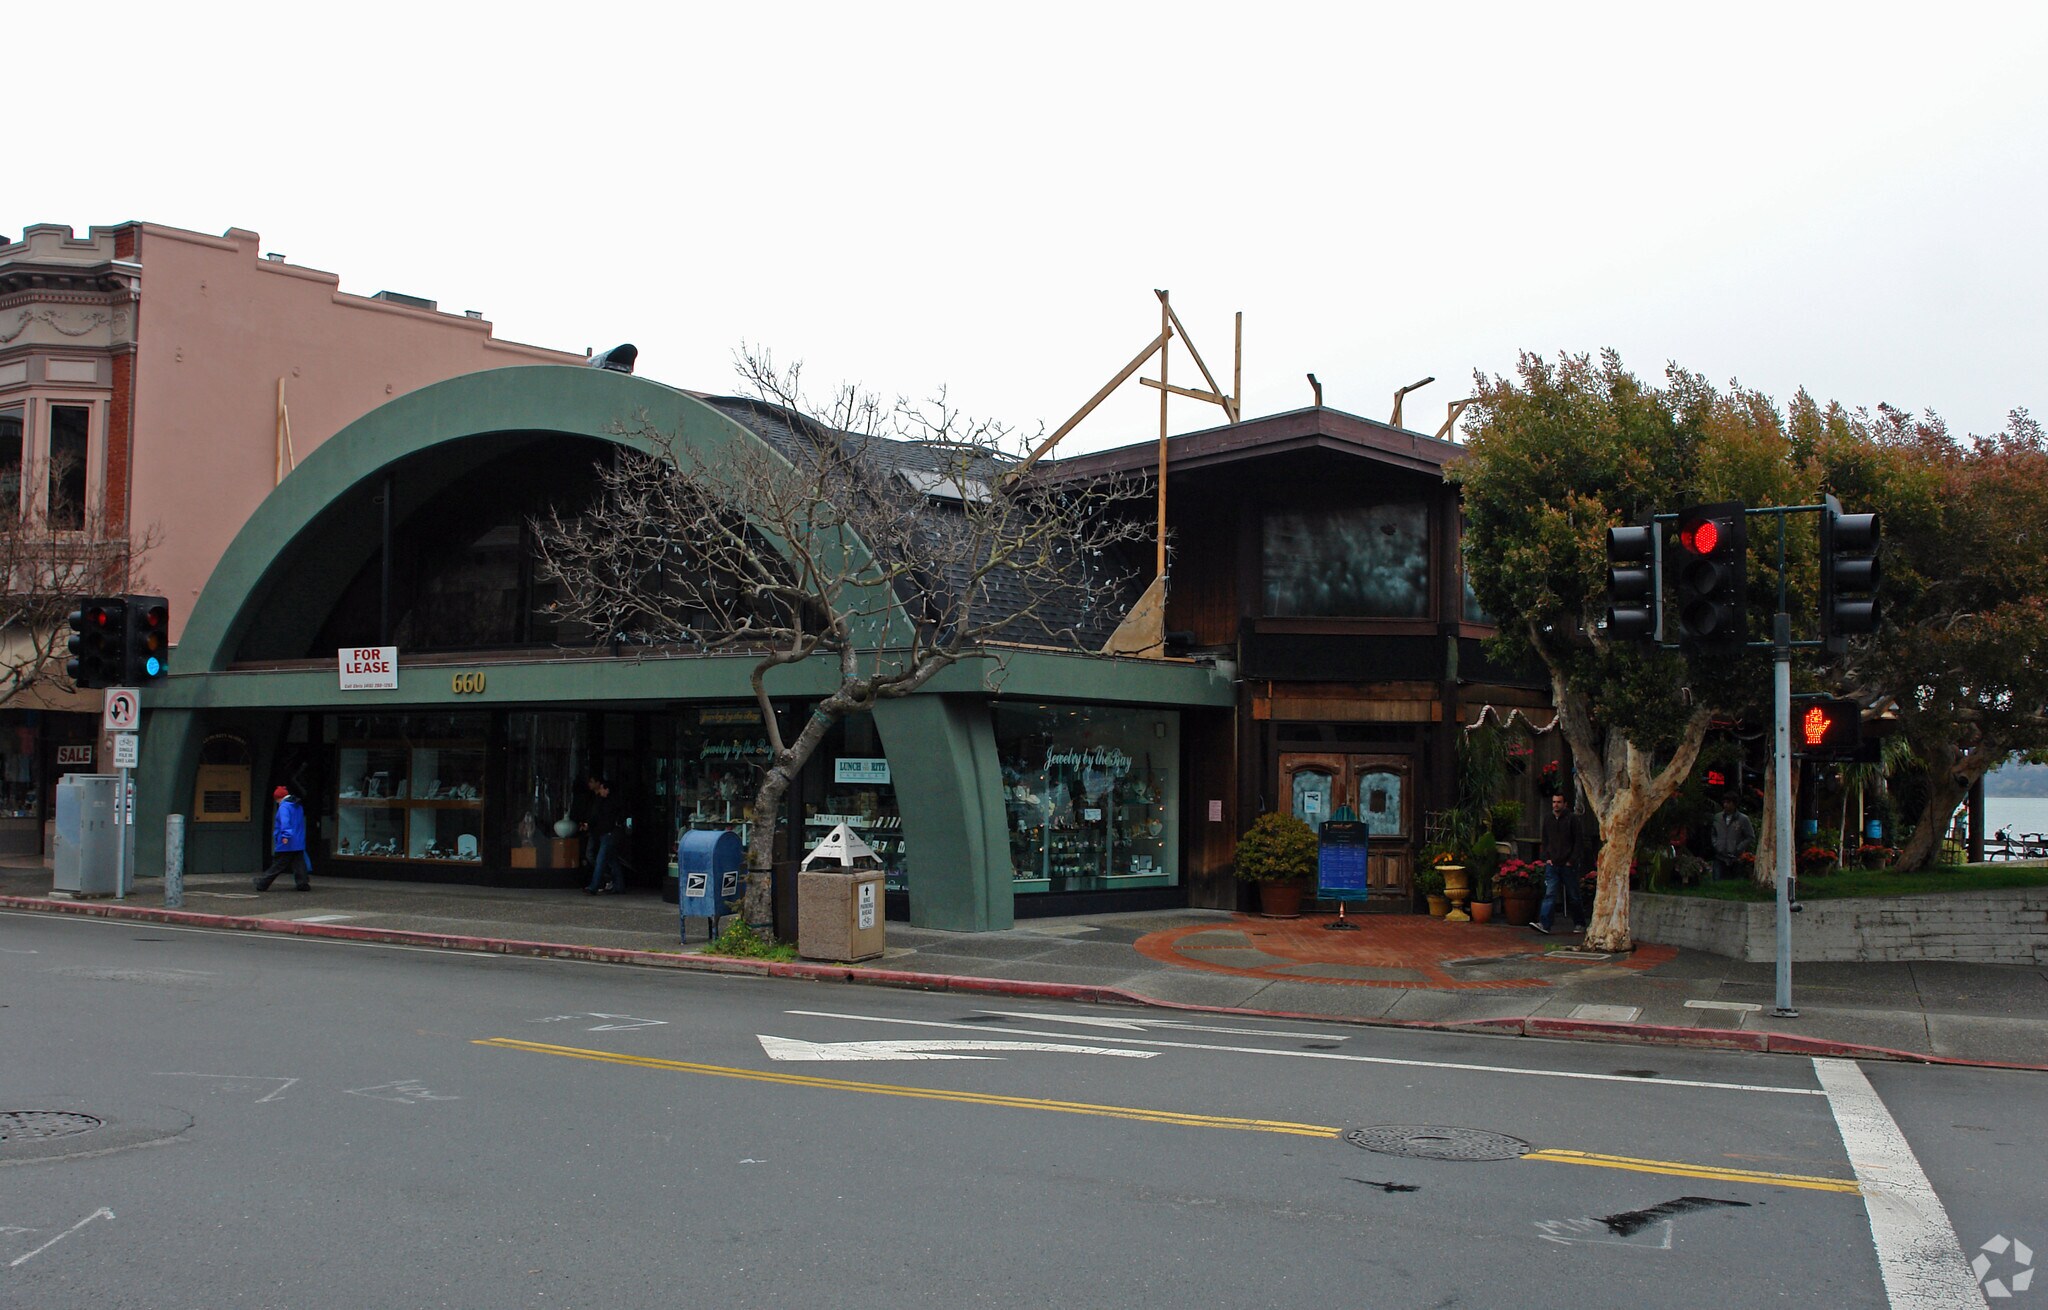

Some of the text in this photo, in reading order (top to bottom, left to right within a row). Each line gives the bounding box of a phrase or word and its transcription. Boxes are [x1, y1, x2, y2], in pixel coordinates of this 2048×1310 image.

[354, 649, 380, 660] FOR
[346, 662, 389, 673] LEASE
[452, 672, 486, 694] 660
[60, 747, 90, 762] SALE
[699, 738, 731, 761] Jewelry
[732, 739, 742, 761] by
[840, 761, 862, 771] LUNCH
[871, 762, 886, 771] RITZ
[1044, 745, 1081, 772] Jewelry
[1083, 748, 1094, 772] by
[1111, 748, 1132, 773] Bay
